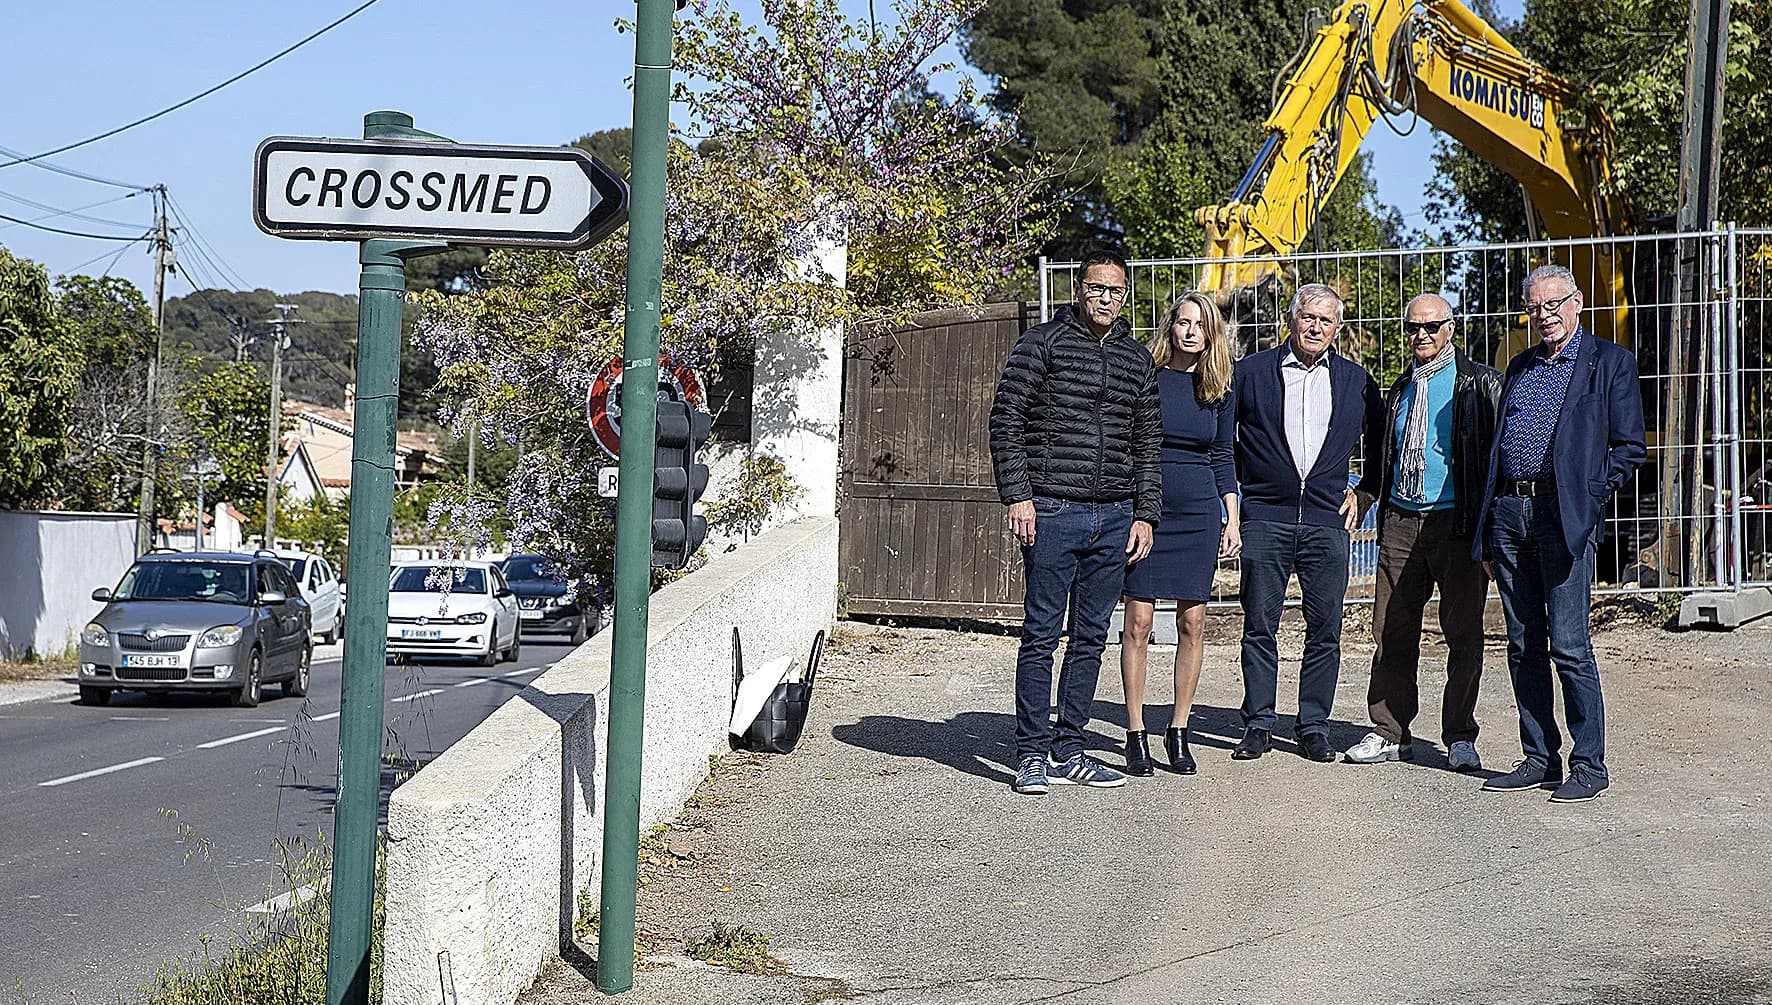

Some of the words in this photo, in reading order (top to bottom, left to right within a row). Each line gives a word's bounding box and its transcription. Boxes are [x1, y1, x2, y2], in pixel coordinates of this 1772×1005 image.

[1450, 64, 1529, 121] KOMATSU
[285, 166, 552, 216] CROSSMED
[167, 656, 177, 666] 13
